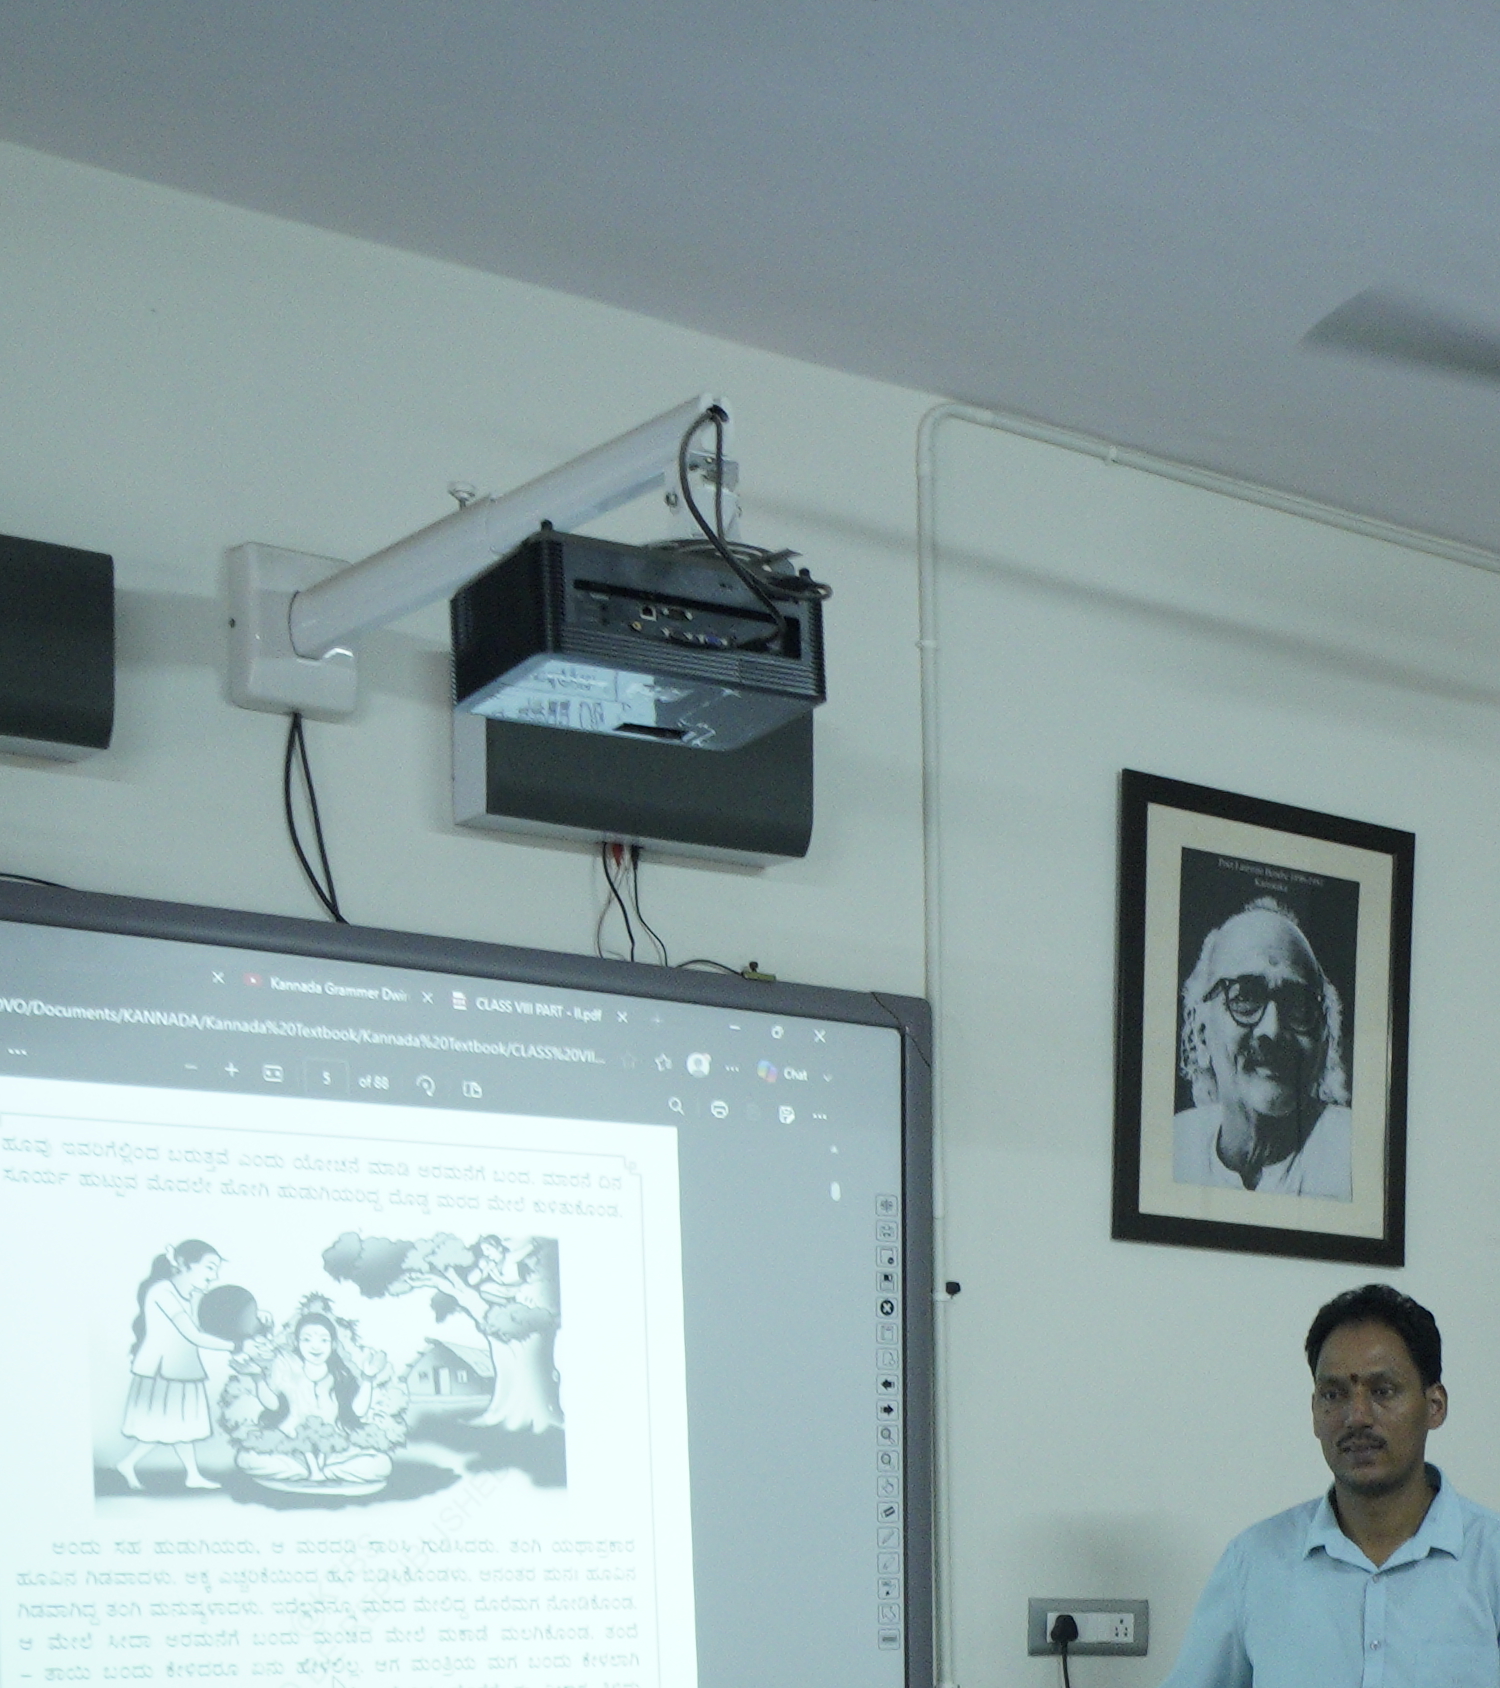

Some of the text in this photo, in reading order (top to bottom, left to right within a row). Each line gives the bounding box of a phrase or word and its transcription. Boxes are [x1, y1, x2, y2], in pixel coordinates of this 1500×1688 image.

[269, 975, 323, 995] Kannada
[324, 981, 380, 1000] Grammer
[475, 997, 513, 1015] CLASS
[514, 1000, 533, 1016] VIII
[535, 1002, 564, 1020] PART
[322, 1071, 332, 1086] 5
[358, 1073, 390, 1091] of 88
[783, 1066, 808, 1083] Chat
